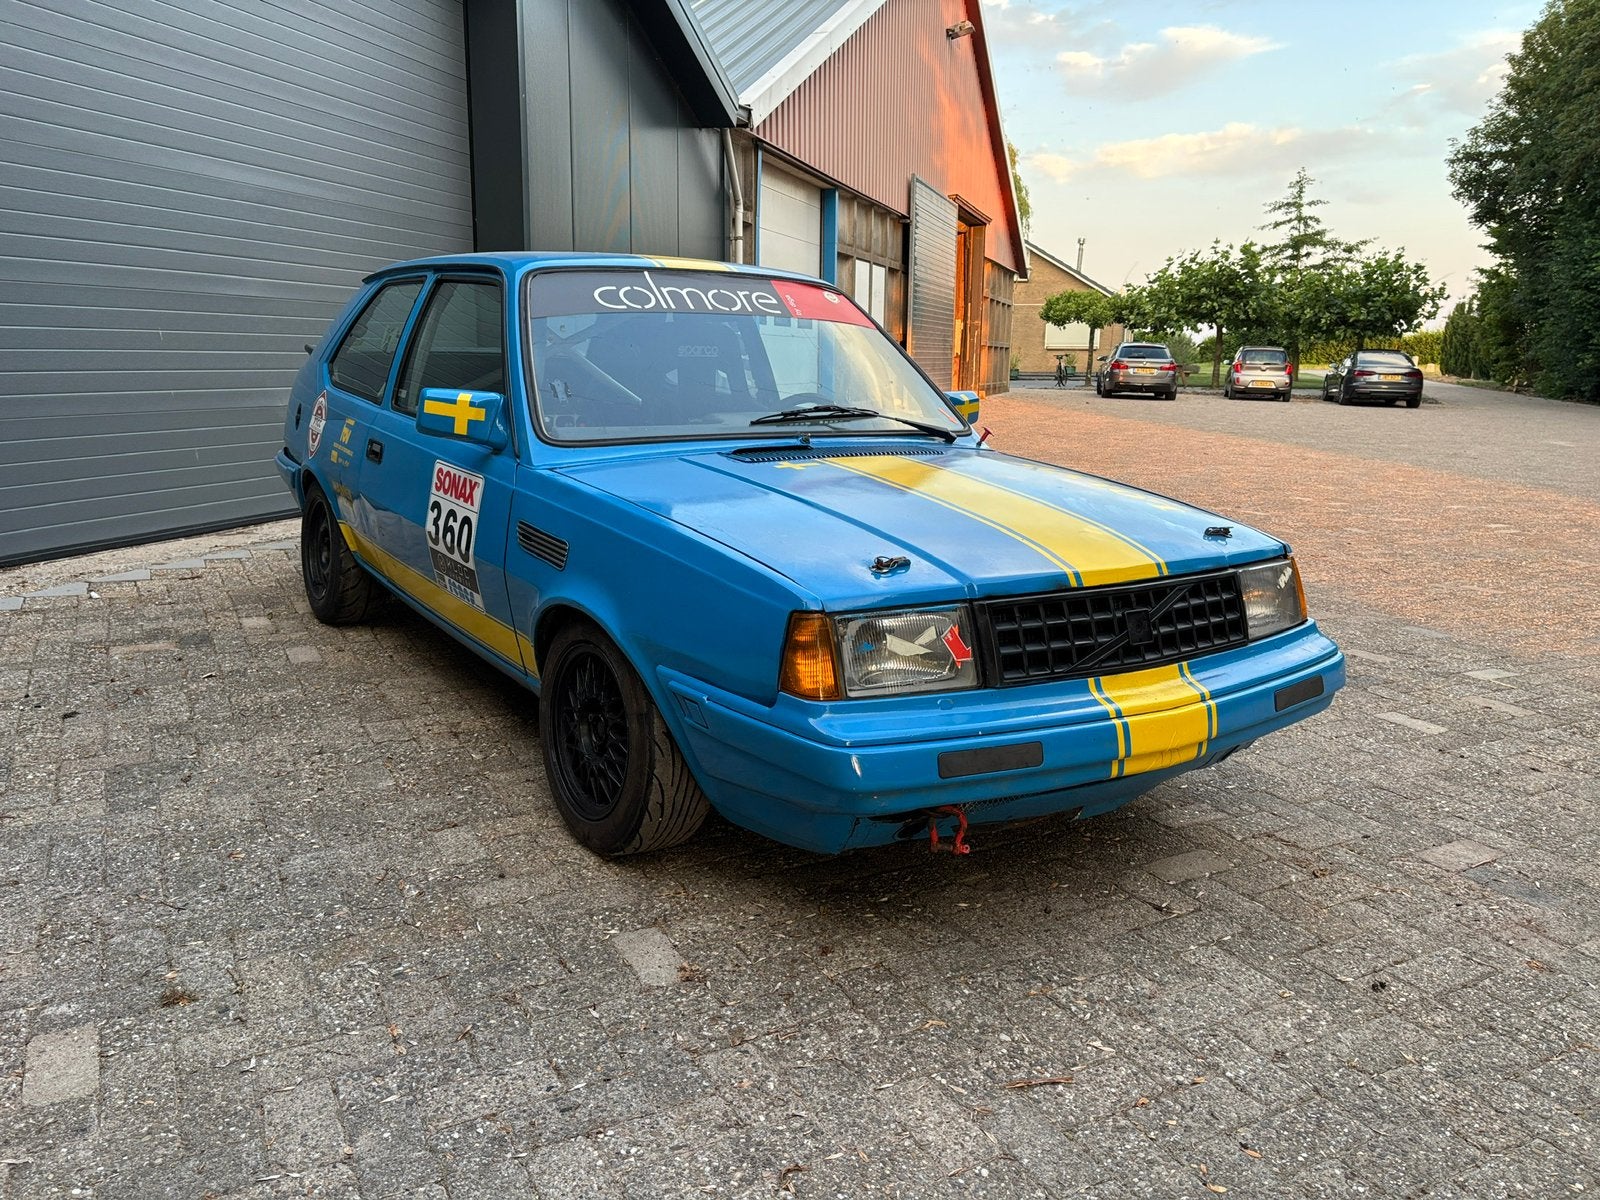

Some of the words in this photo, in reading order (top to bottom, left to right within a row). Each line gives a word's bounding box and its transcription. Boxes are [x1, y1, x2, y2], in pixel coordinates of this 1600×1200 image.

[594, 271, 782, 314] colmore
[434, 467, 479, 507] SONAX
[427, 500, 473, 564] 360
